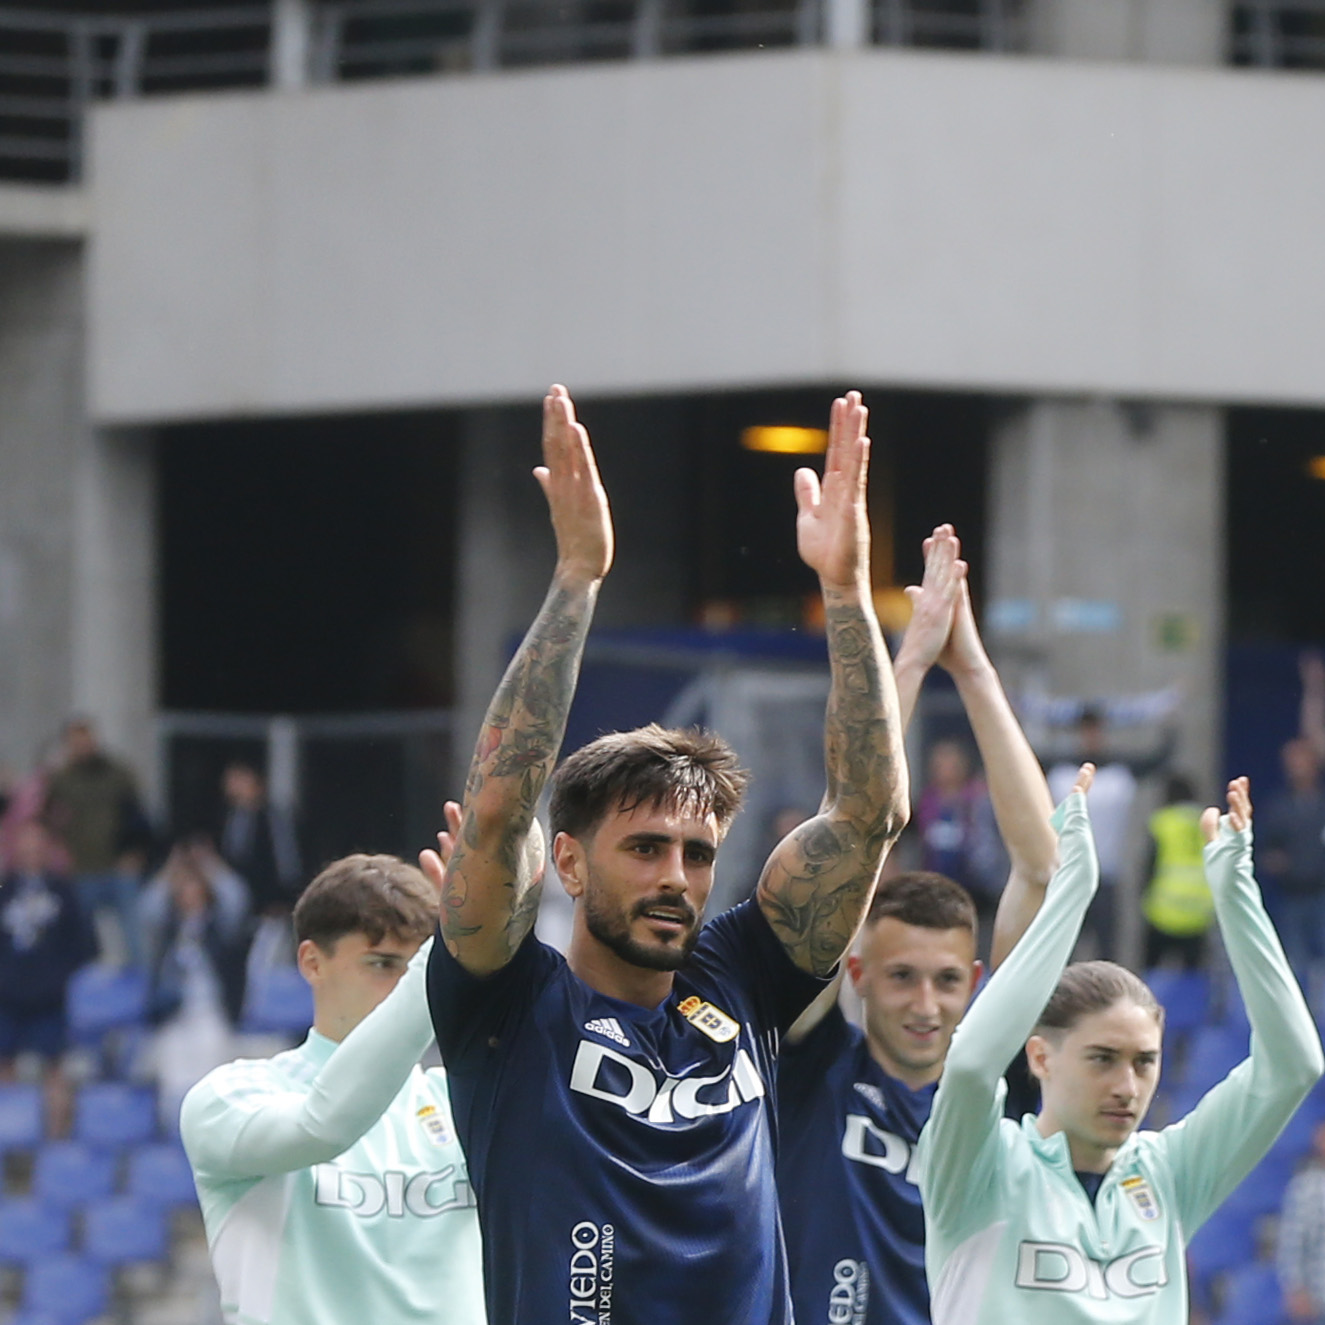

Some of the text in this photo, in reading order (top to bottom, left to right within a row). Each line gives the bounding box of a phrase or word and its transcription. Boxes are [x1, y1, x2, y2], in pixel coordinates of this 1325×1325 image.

[584, 1021, 631, 1048] adidas
[570, 1039, 765, 1123] DIGI
[600, 1223, 614, 1282] CAMINO
[599, 1283, 613, 1310] DEL
